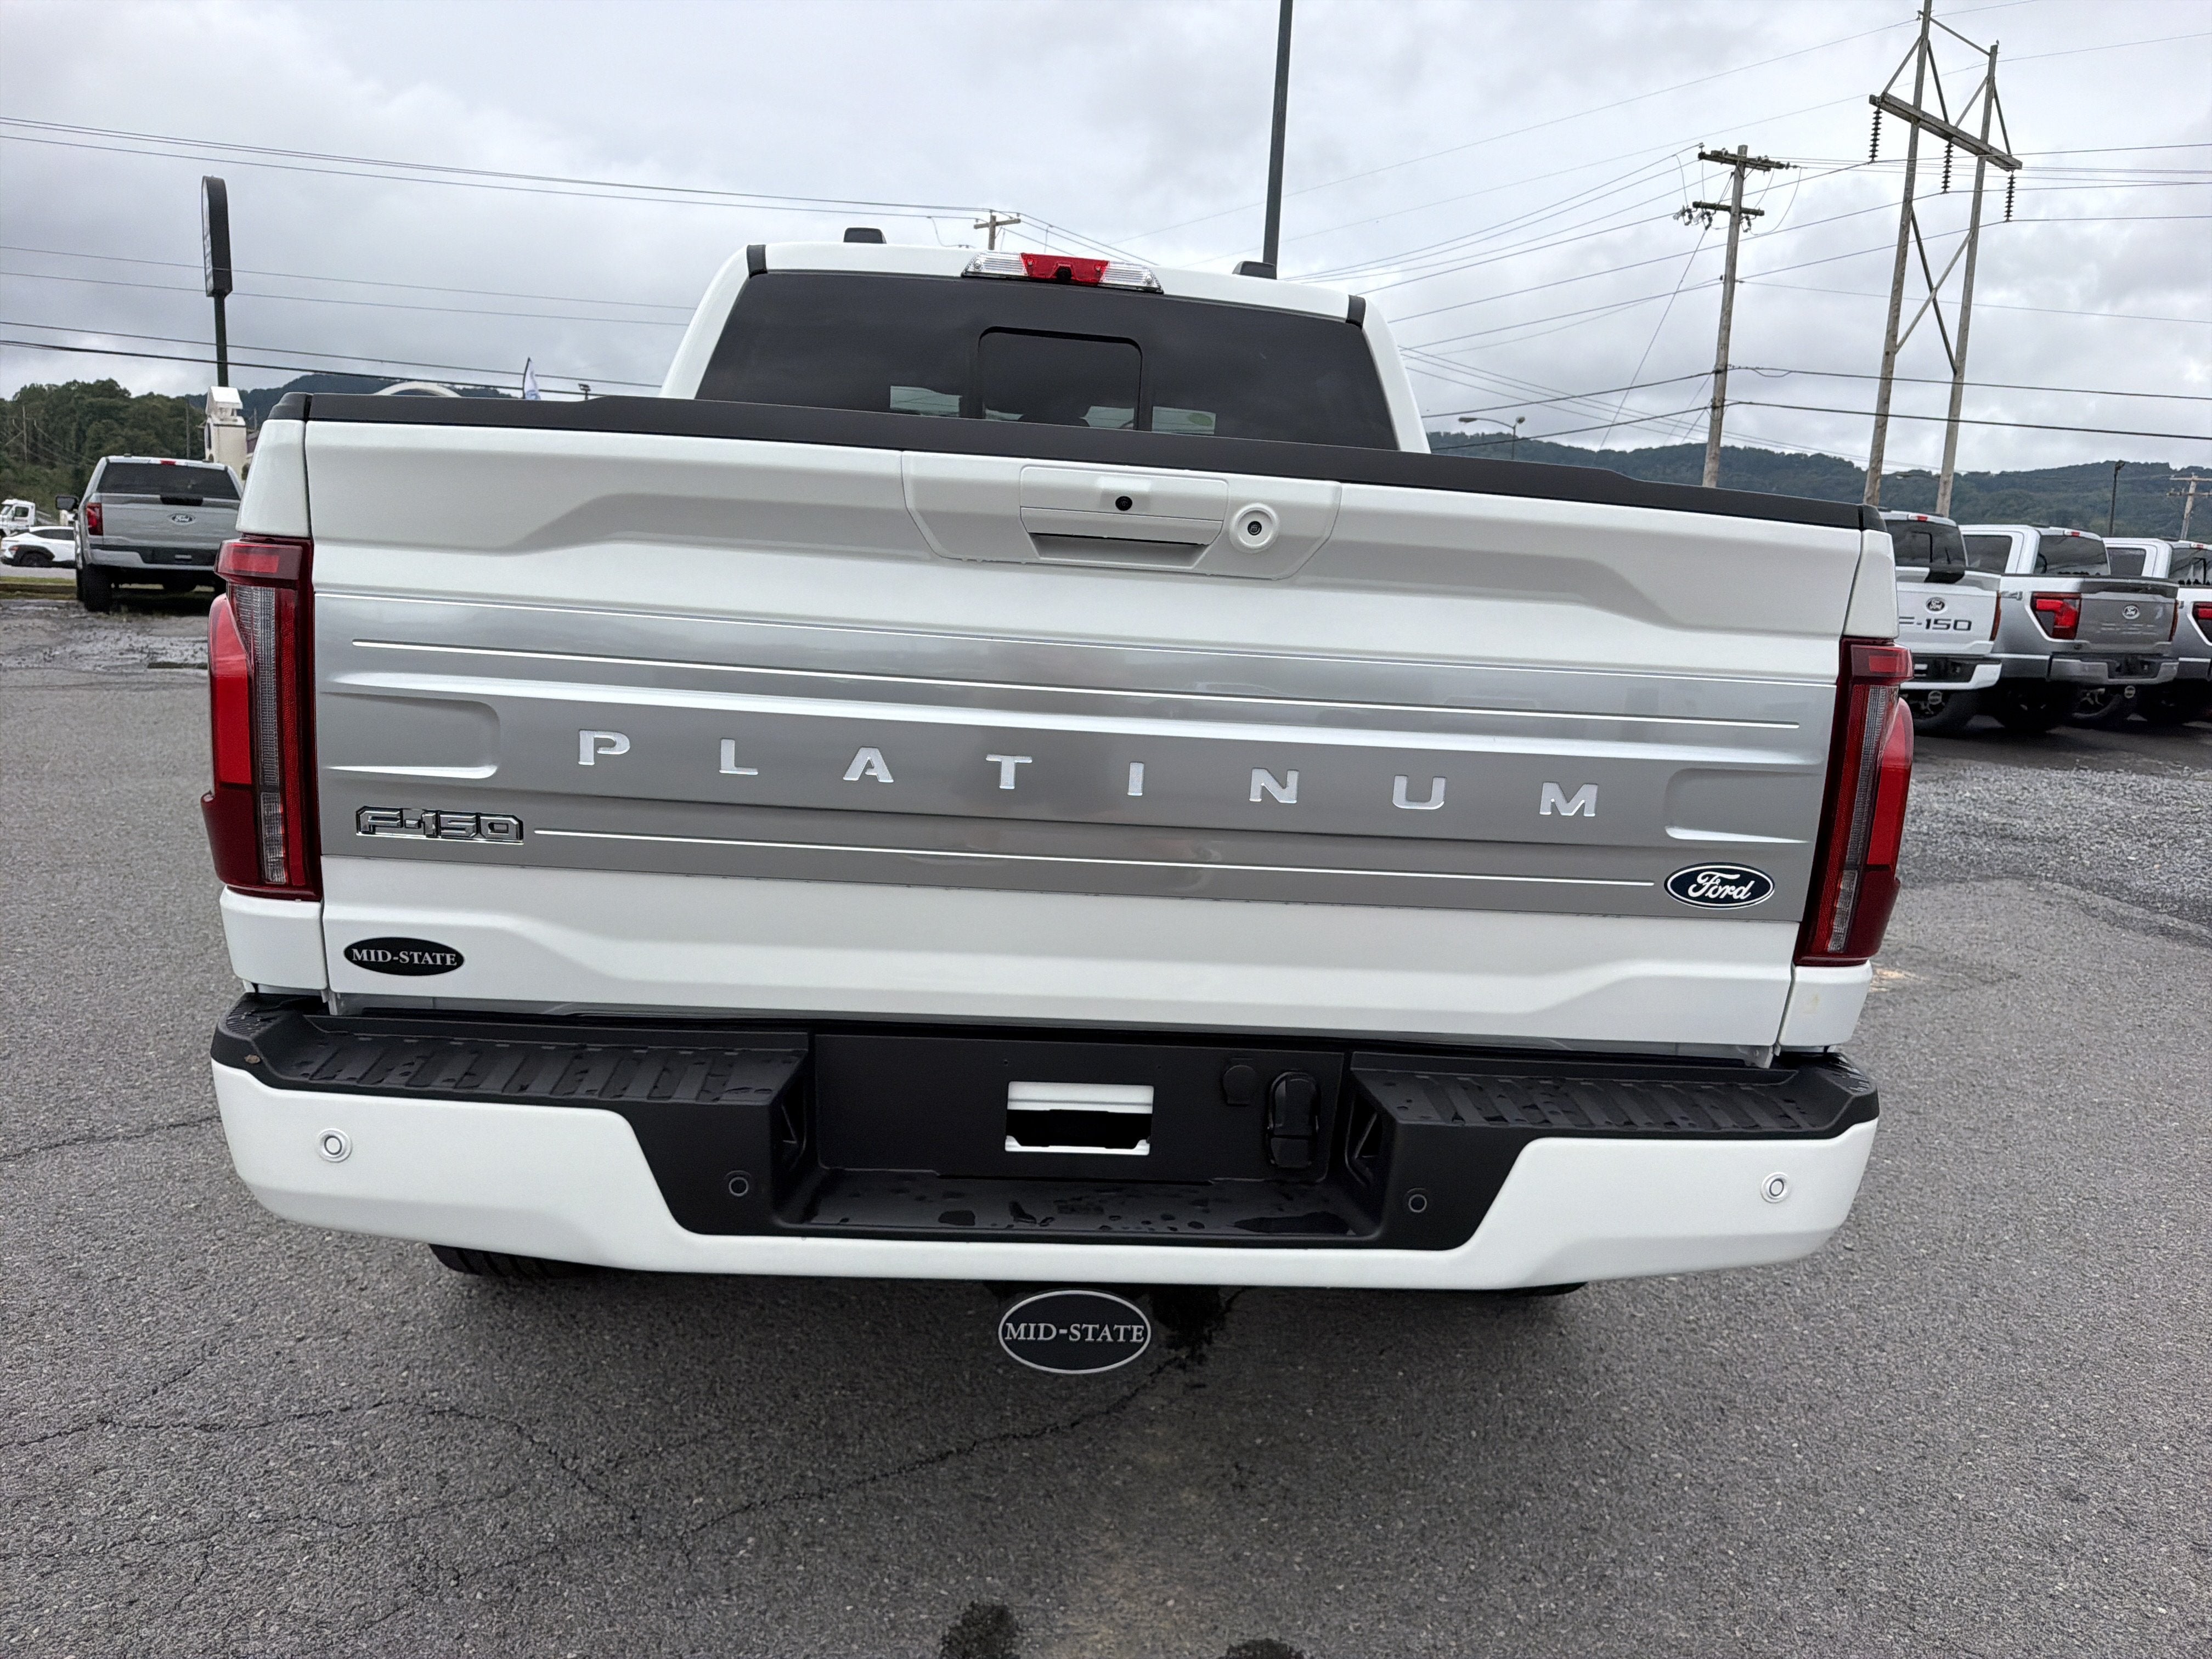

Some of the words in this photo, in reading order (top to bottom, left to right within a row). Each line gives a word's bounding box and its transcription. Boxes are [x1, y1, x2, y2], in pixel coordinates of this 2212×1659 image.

[578, 729, 1599, 816] PLATINUM
[356, 805, 523, 845] F-150
[1688, 871, 1755, 900] Ford
[352, 949, 457, 966] MID-STATE
[1005, 1323, 1145, 1342] MID-STATE
